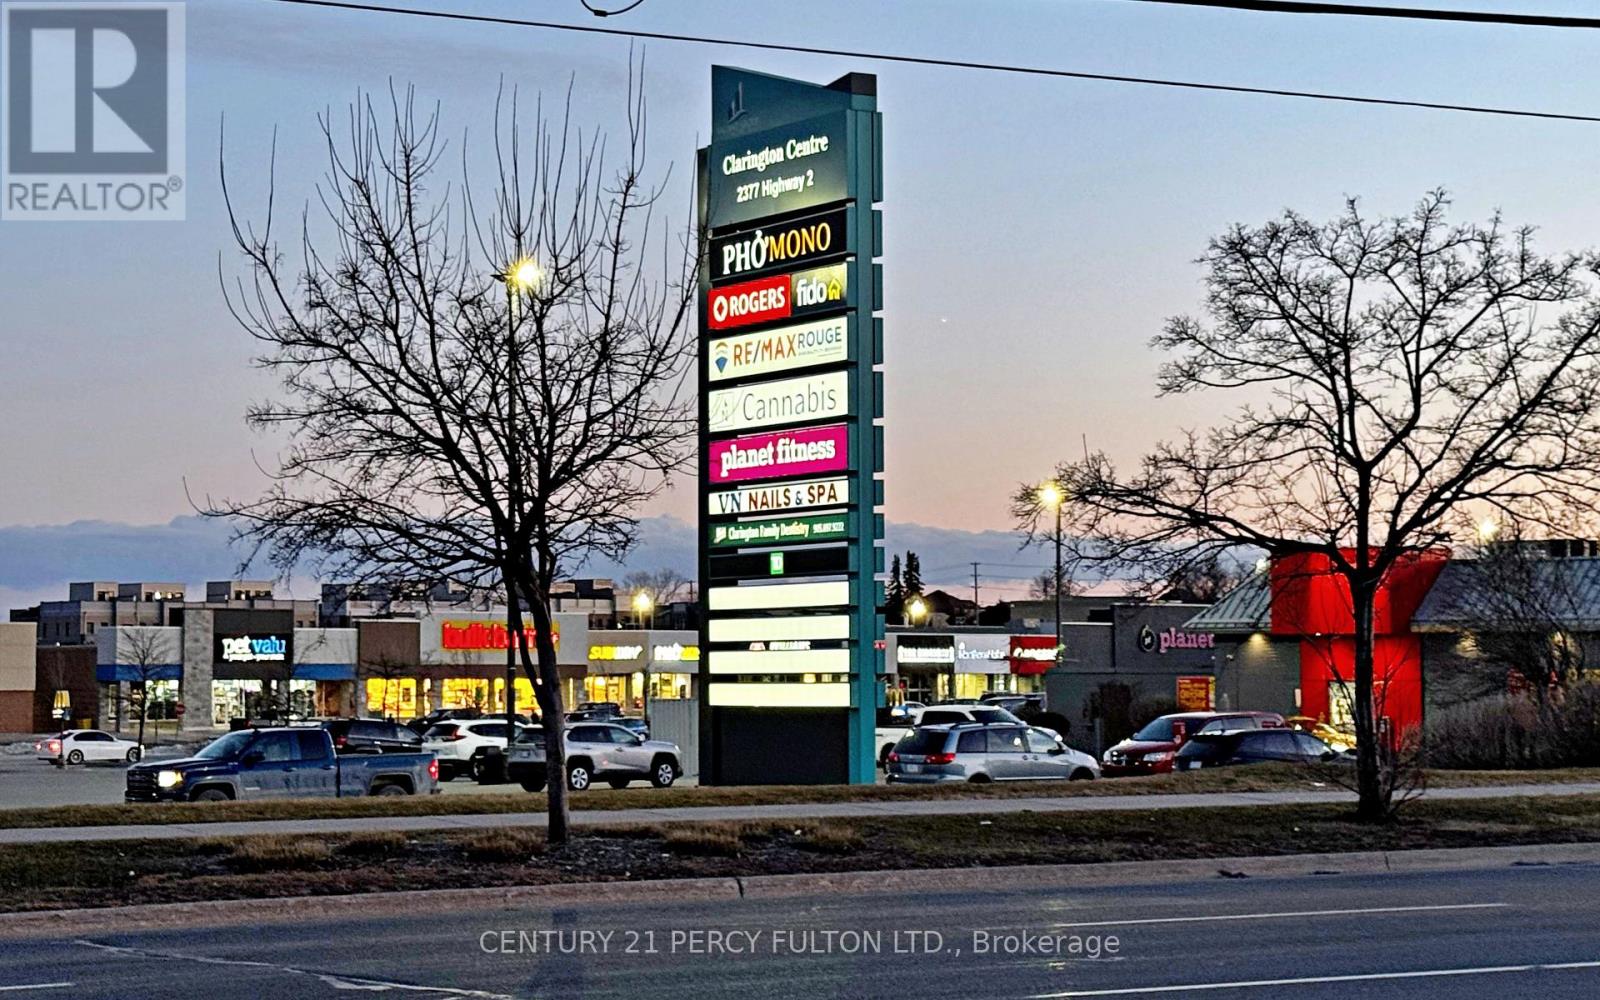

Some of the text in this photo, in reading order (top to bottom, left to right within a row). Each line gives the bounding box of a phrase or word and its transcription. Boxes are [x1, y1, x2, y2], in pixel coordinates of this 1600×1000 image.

[722, 134, 829, 176] Clarington Centre
[736, 168, 815, 203] 2377 Highway 2
[729, 286, 786, 317] ROGERS
[796, 277, 827, 307] fido
[733, 333, 797, 367] RE/MAX
[797, 326, 842, 349] ROUGE
[743, 380, 837, 421] Cannabis
[720, 437, 836, 478] planet fitness
[718, 482, 838, 513] VN NAILS & SPA
[252, 636, 286, 653] valu
